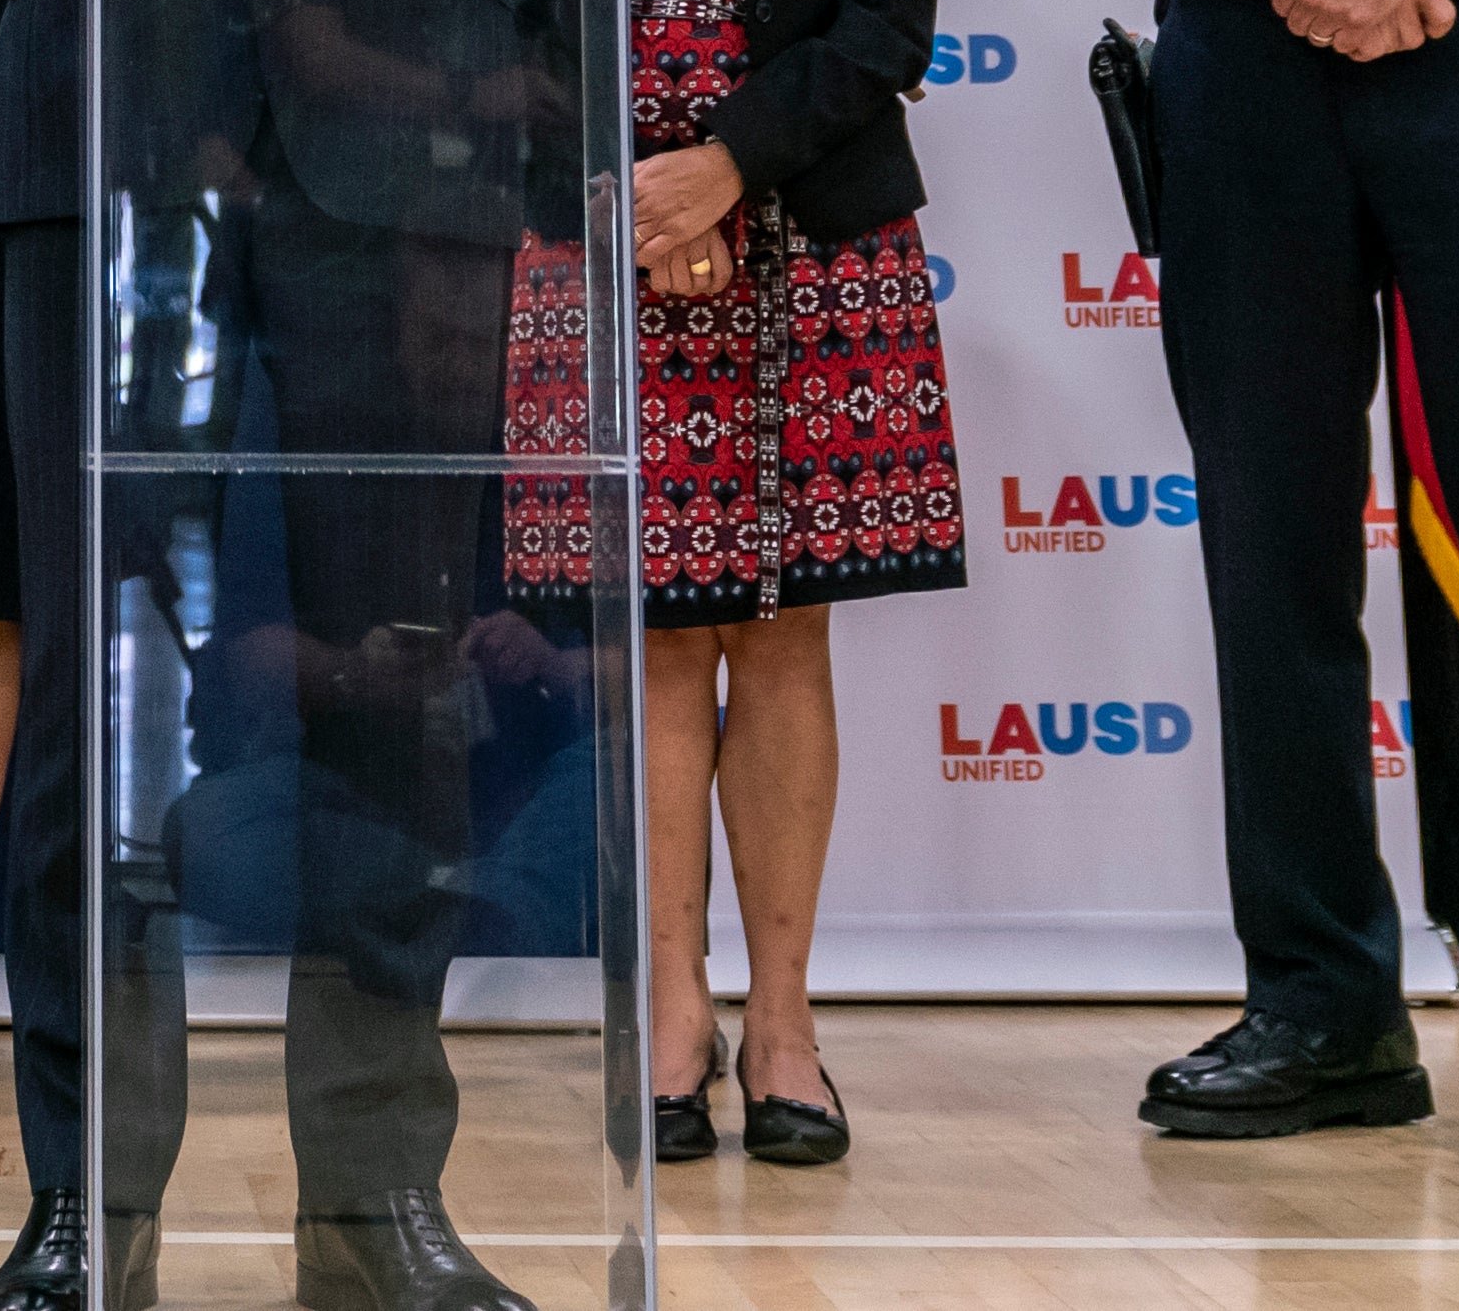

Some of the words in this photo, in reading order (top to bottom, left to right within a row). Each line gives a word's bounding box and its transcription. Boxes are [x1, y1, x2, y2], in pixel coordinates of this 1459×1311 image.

[1002, 474, 1200, 527] LAUS
[1004, 531, 1106, 553] UNIFIED
[939, 702, 1192, 755] LAUSD
[942, 761, 1044, 782] UNIFIED
